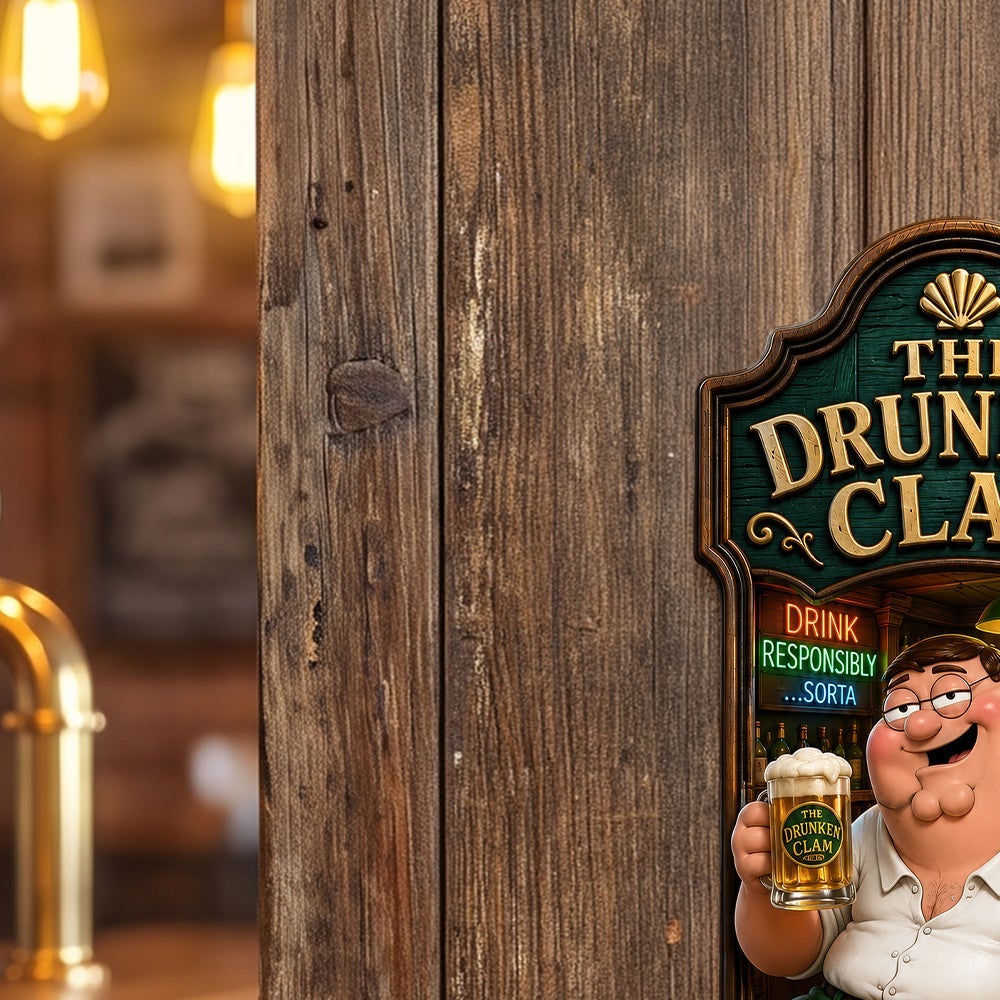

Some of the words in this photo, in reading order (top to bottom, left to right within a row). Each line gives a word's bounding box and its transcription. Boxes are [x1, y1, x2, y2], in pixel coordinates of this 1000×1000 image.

[786, 603, 859, 643] DRINK
[762, 639, 877, 677] RESPONSIBLY
[784, 680, 857, 706] ...SORTA
[800, 809, 823, 819] THE
[783, 821, 841, 843] DRUNKEN
[792, 838, 833, 856] CLAM
